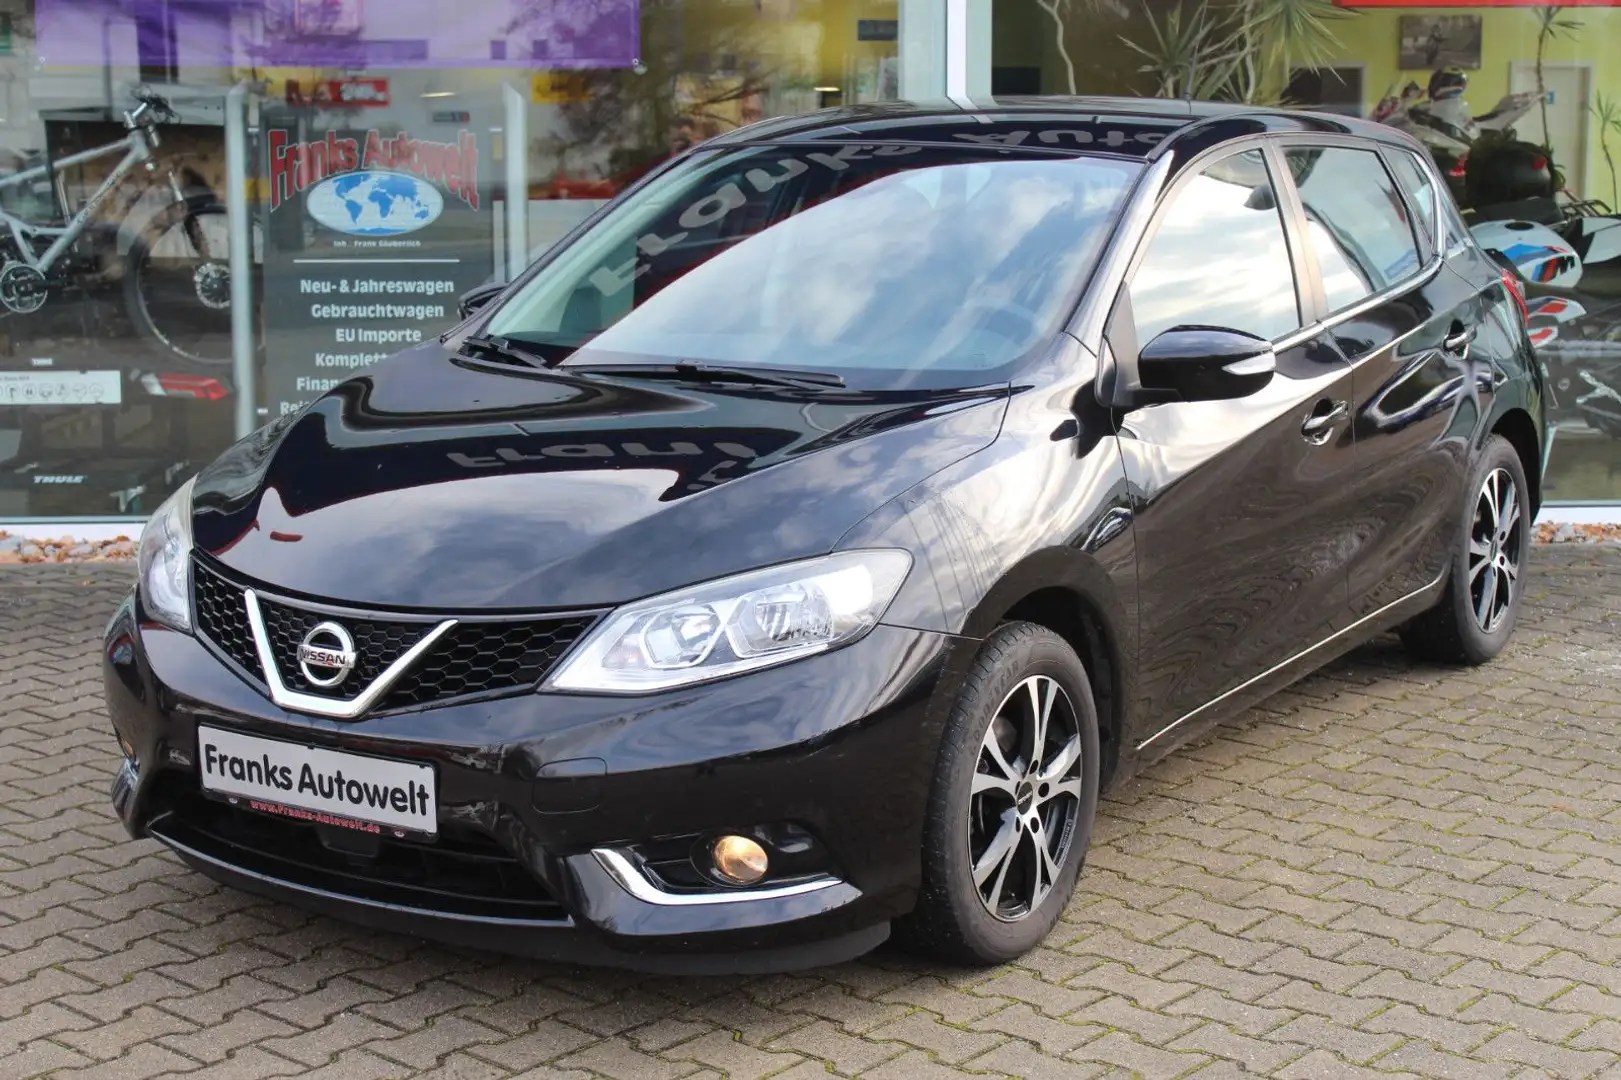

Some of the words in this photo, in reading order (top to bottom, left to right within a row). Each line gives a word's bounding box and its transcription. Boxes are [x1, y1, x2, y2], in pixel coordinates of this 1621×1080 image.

[268, 129, 358, 212] Franks
[360, 129, 479, 212] Autowelt
[300, 279, 336, 293] Neu-
[339, 279, 350, 293] &
[352, 279, 454, 295] Jahreswagen
[311, 304, 444, 320] Gebrauchtwagen
[335, 328, 355, 342] EU
[358, 328, 421, 344] Importe
[33, 475, 84, 484] THULE
[301, 648, 346, 665] NISSAN
[204, 743, 293, 791] Franks
[297, 762, 430, 817] Autowelt
